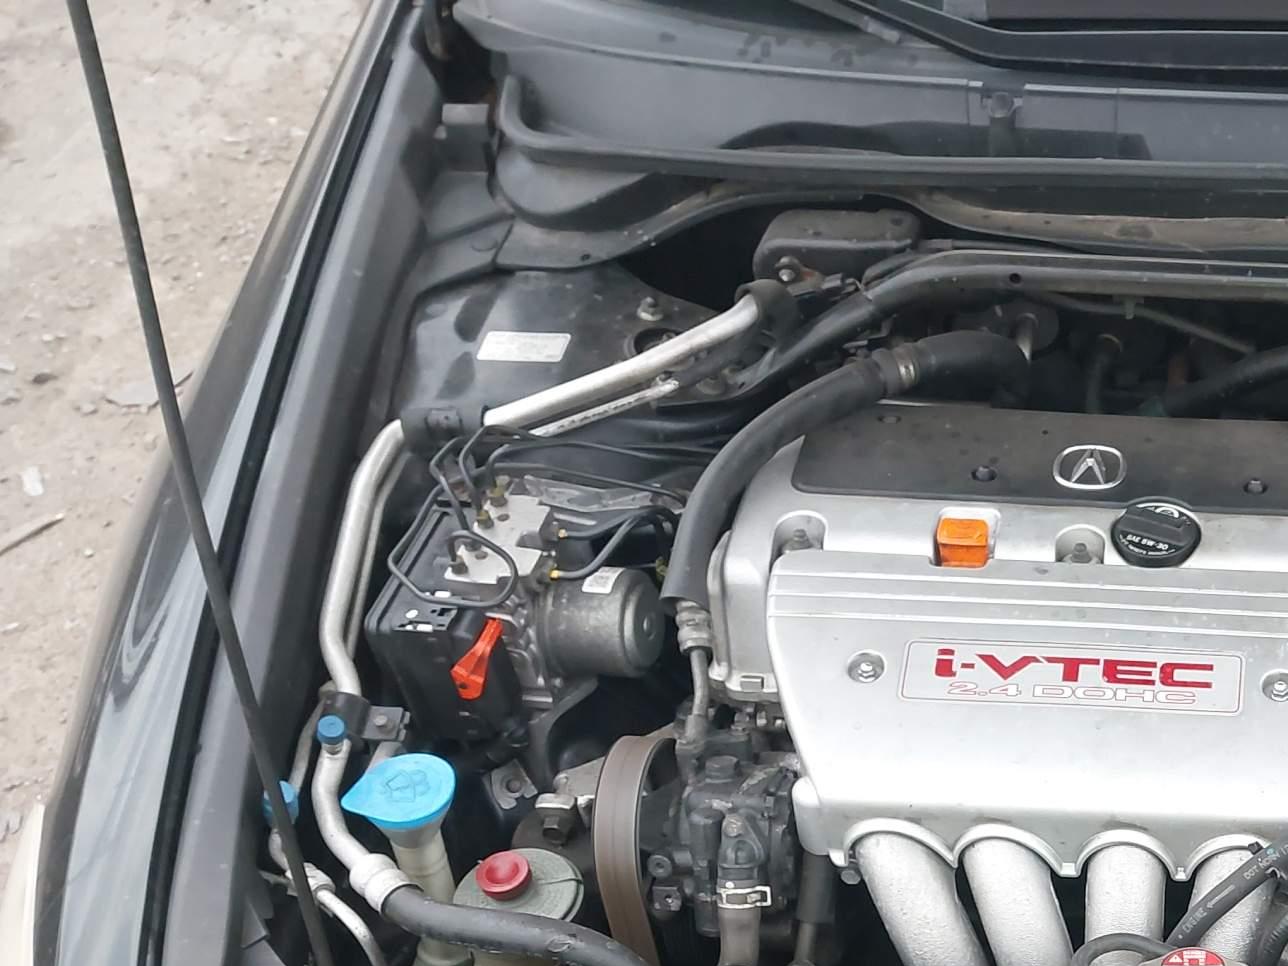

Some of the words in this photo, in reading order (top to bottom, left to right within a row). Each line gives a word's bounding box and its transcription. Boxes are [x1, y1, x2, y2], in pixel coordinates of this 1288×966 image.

[935, 648, 1214, 688] i-VTEC
[947, 681, 1022, 697] 2.4
[1032, 683, 1196, 704] DOHC
